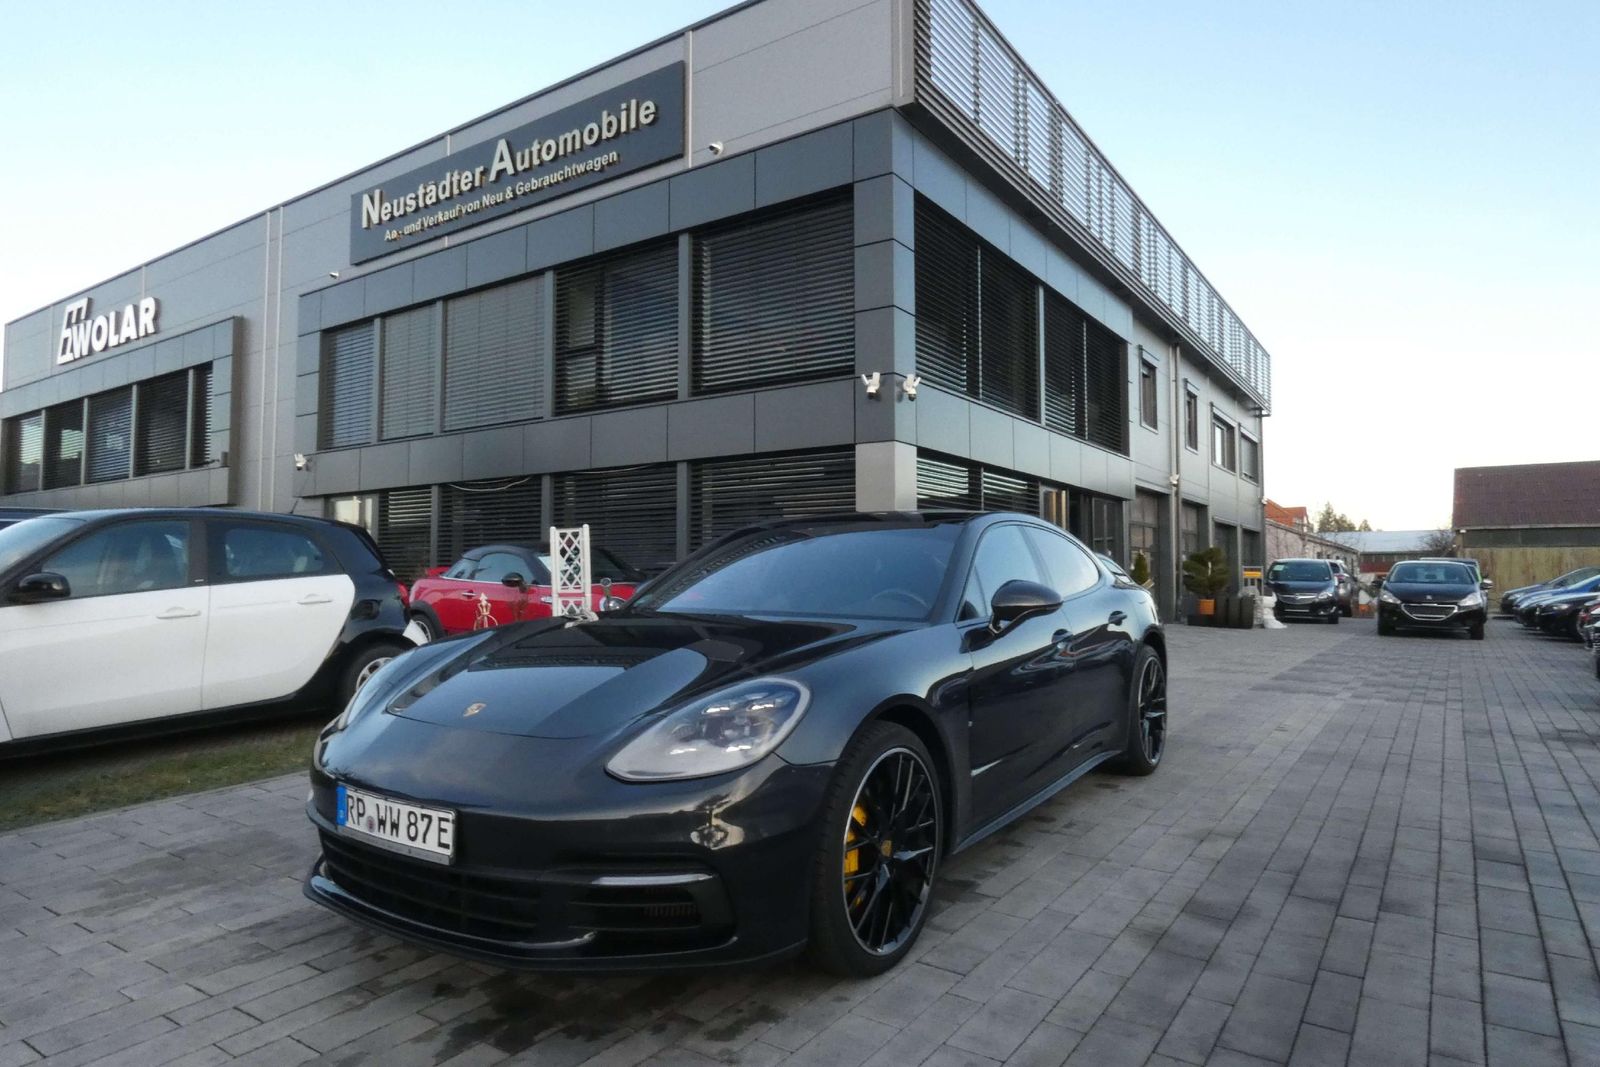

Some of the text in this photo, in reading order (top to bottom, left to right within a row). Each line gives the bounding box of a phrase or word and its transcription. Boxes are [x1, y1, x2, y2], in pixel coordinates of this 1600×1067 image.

[361, 98, 657, 229] Neustädter Automobile
[404, 218, 421, 235] und
[423, 203, 462, 228] Verkauf
[461, 199, 481, 214] von
[482, 189, 503, 209] Neu
[505, 185, 513, 199] &
[515, 150, 618, 196] Gebrauchtwagen
[346, 794, 451, 850] RP WW 87E
